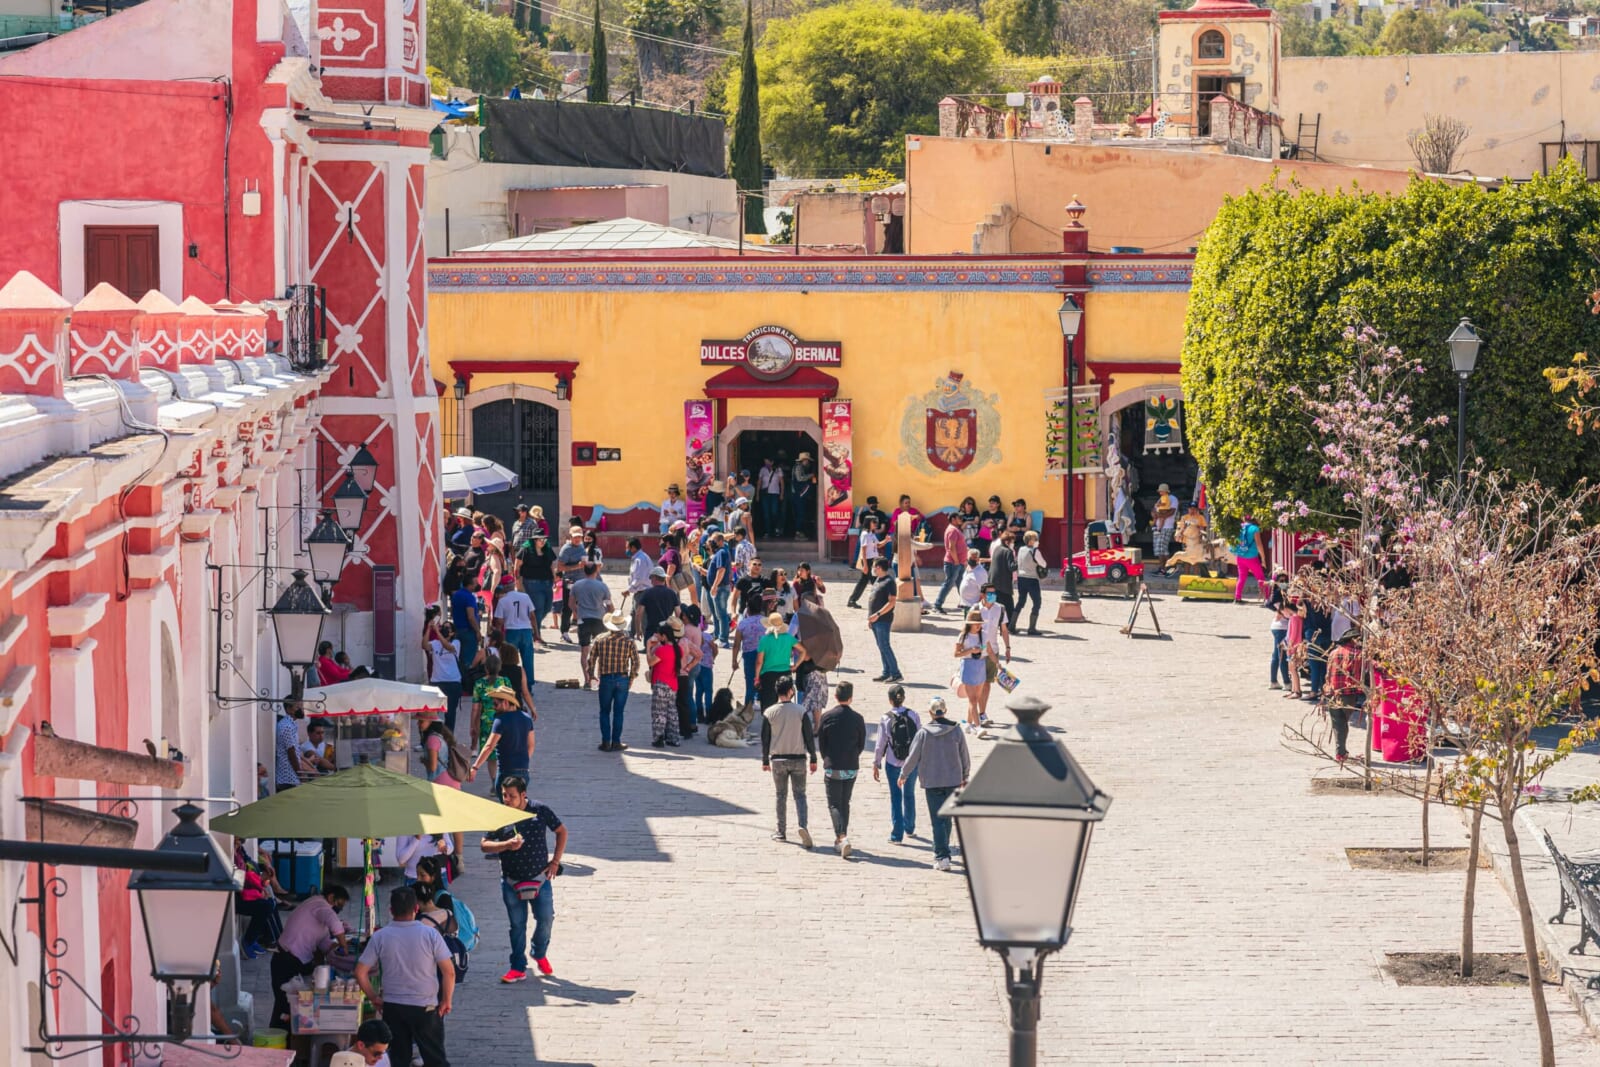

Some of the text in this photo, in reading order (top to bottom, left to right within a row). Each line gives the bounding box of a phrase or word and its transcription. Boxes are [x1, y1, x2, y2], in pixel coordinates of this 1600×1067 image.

[743, 326, 799, 345] TRADICIONALES
[700, 346, 841, 361] DULCES BERNAL
[513, 600, 520, 618] 7
